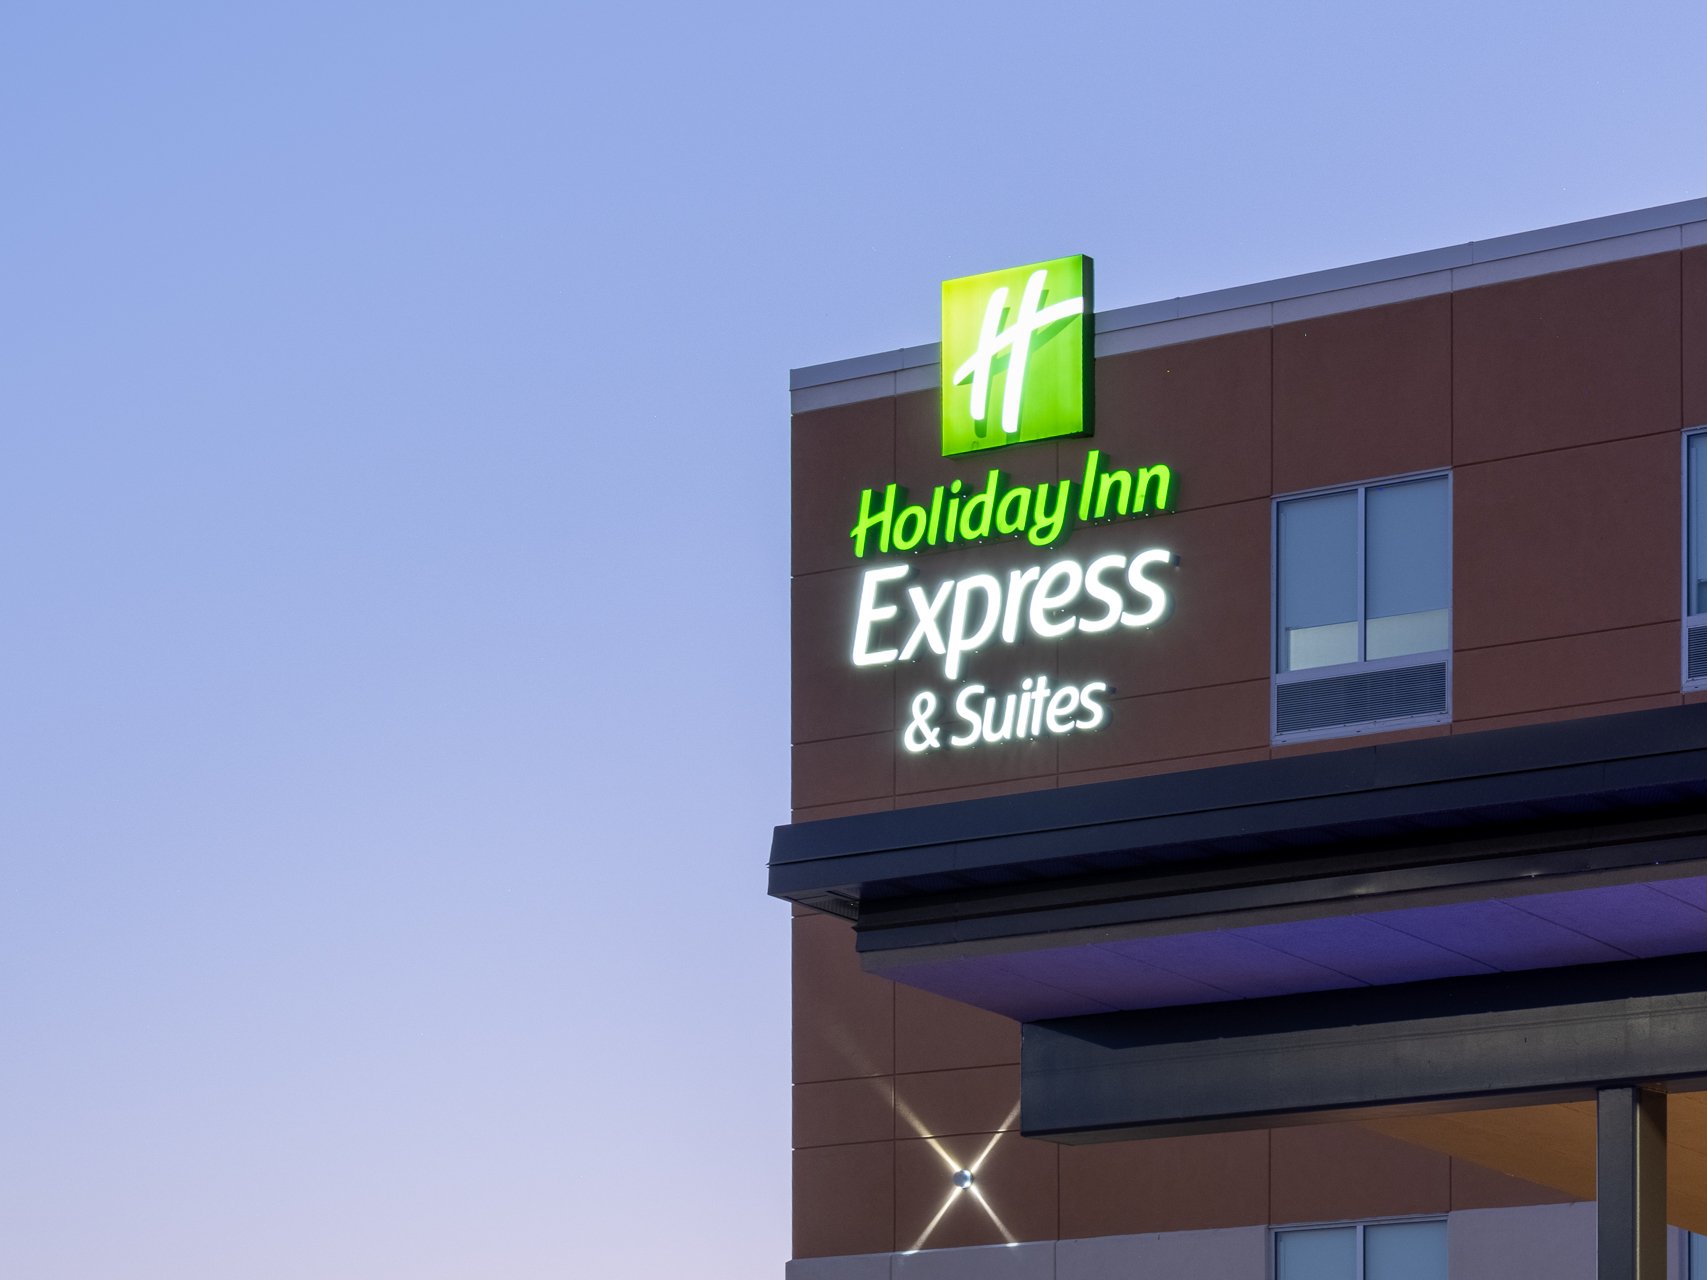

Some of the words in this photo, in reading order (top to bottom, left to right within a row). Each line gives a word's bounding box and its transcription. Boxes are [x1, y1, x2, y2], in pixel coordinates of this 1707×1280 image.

[953, 268, 1084, 433] H
[850, 469, 1070, 558] Holiday
[1079, 449, 1171, 522] Inn
[851, 549, 1171, 680] Express
[903, 690, 941, 754] &
[950, 676, 1107, 747] Suites
